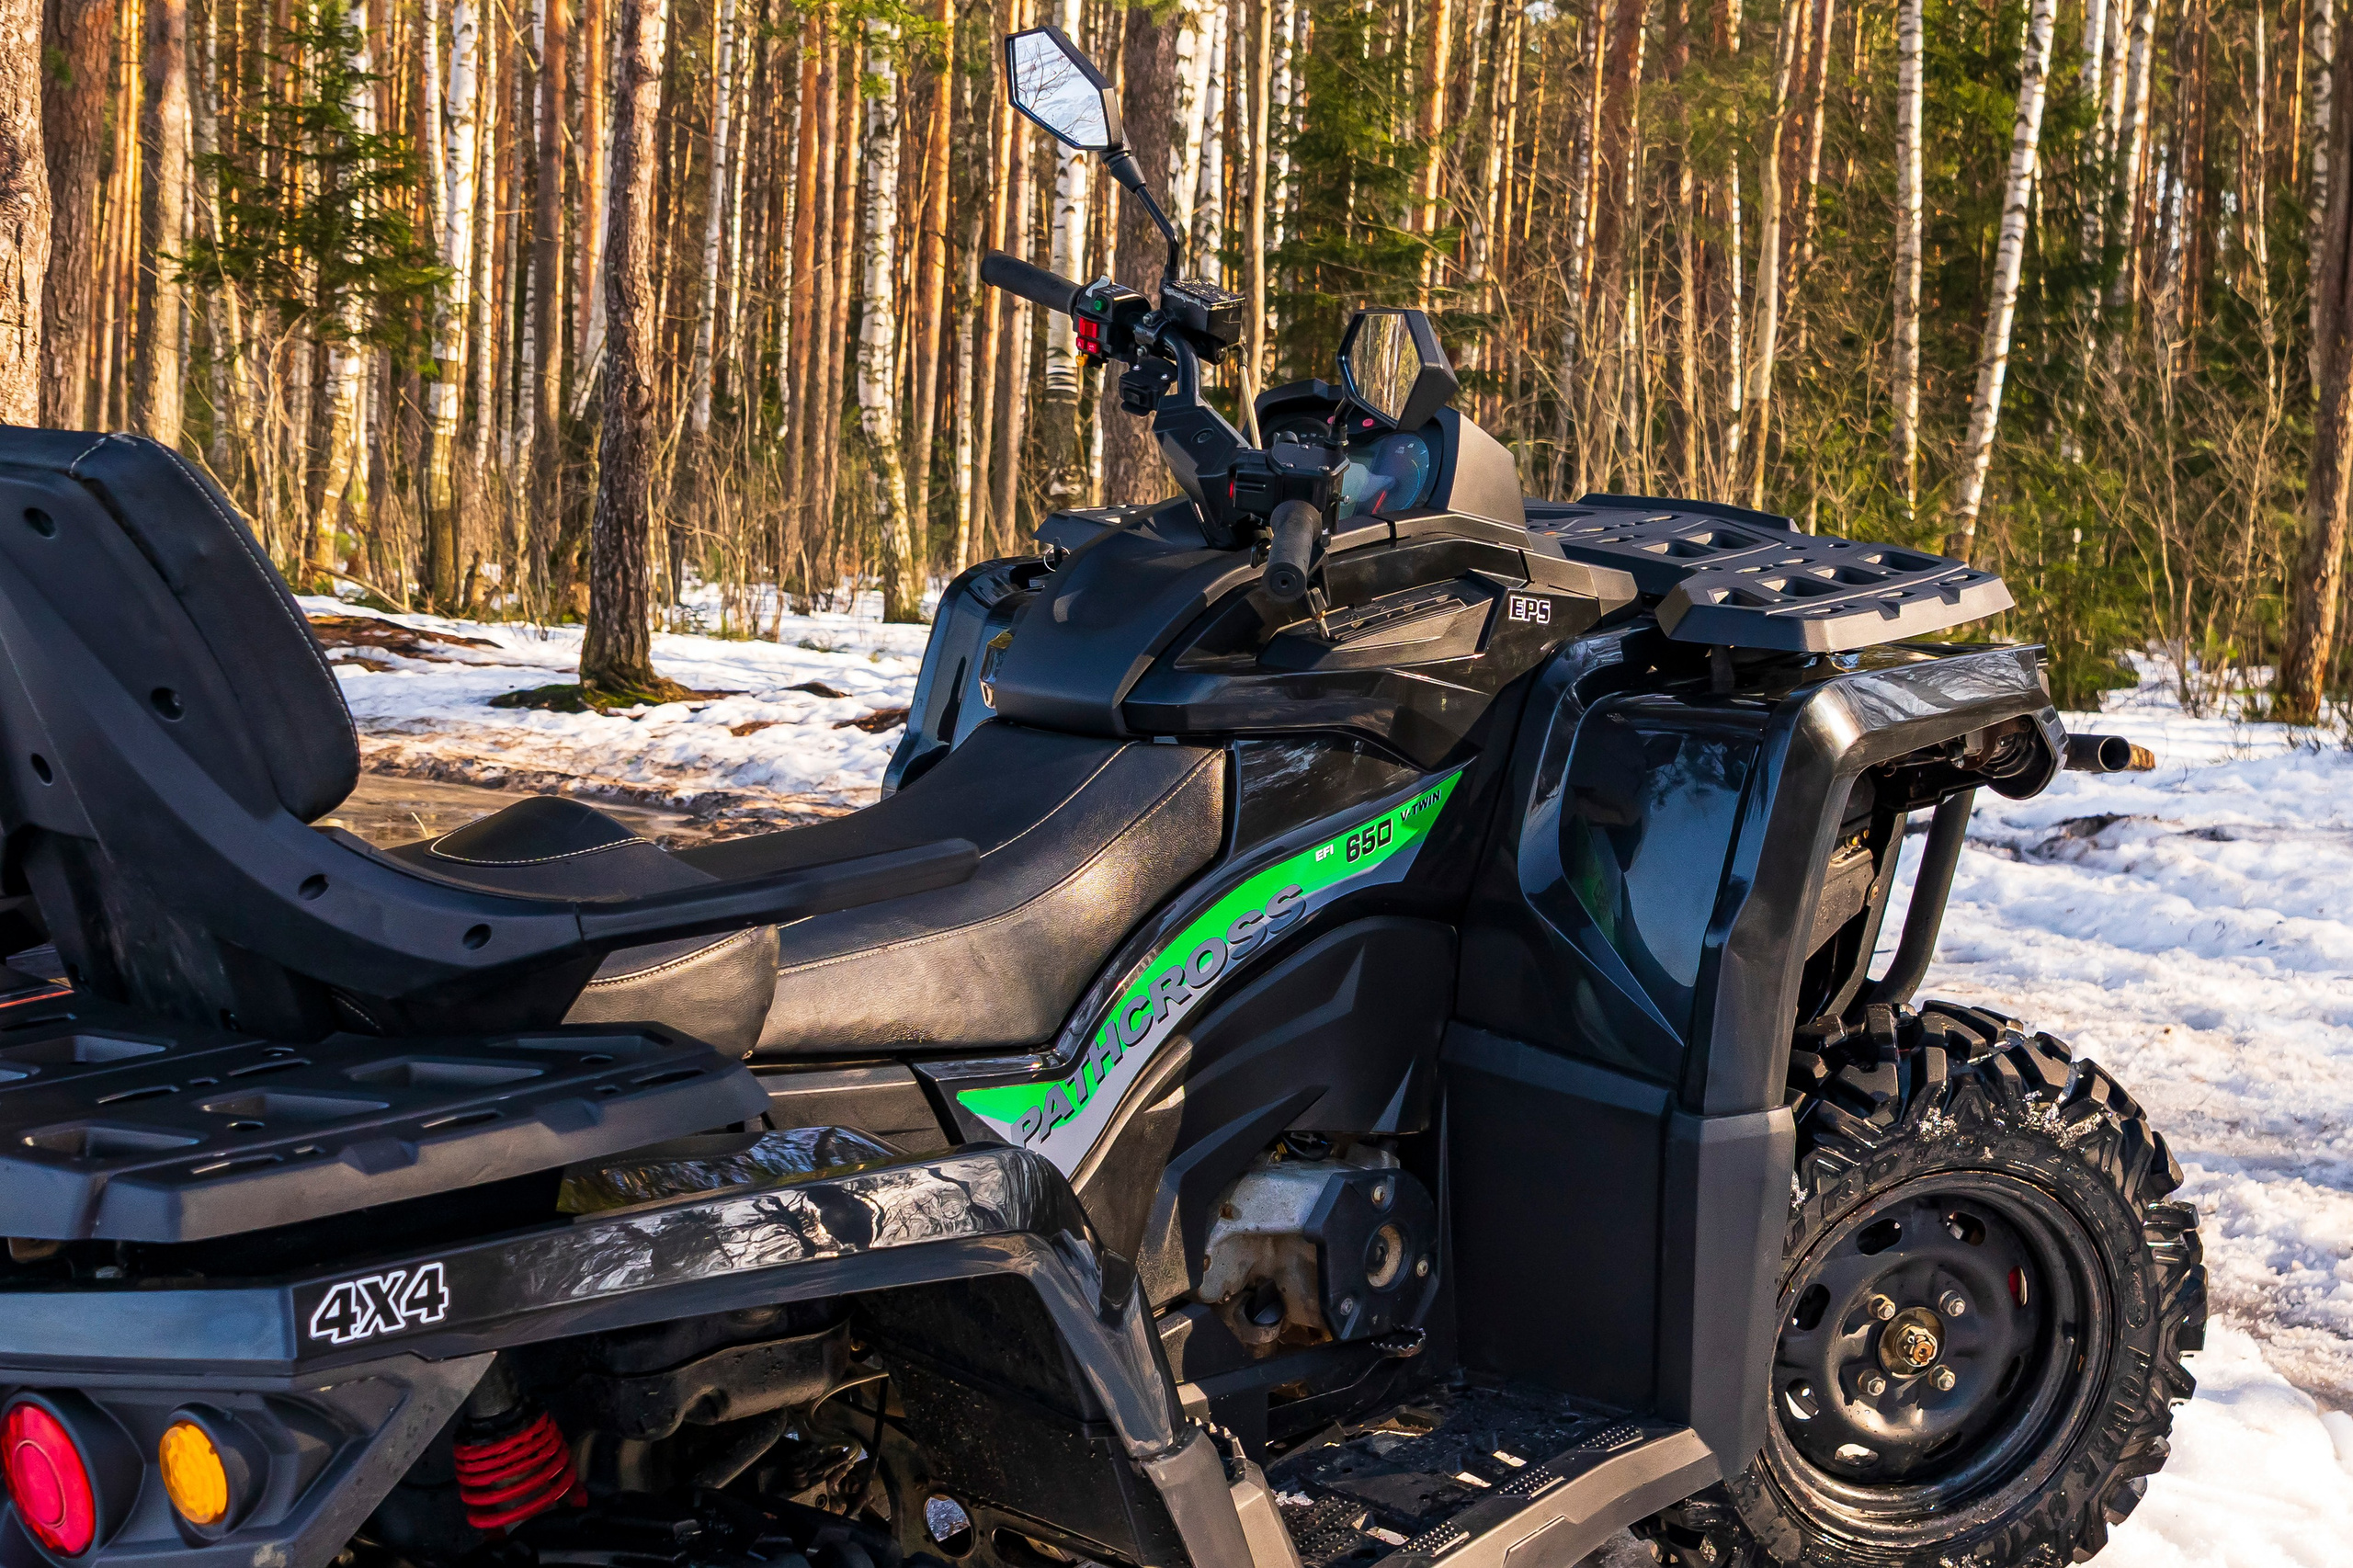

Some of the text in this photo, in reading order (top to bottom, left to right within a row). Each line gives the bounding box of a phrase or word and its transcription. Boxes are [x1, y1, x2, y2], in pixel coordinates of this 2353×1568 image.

[1508, 596, 1551, 624] EPS
[1315, 790, 1442, 864] EFI 650 V-TWIN
[1010, 883, 1307, 1149] PATHCROSS
[310, 1262, 449, 1345] 4X4
